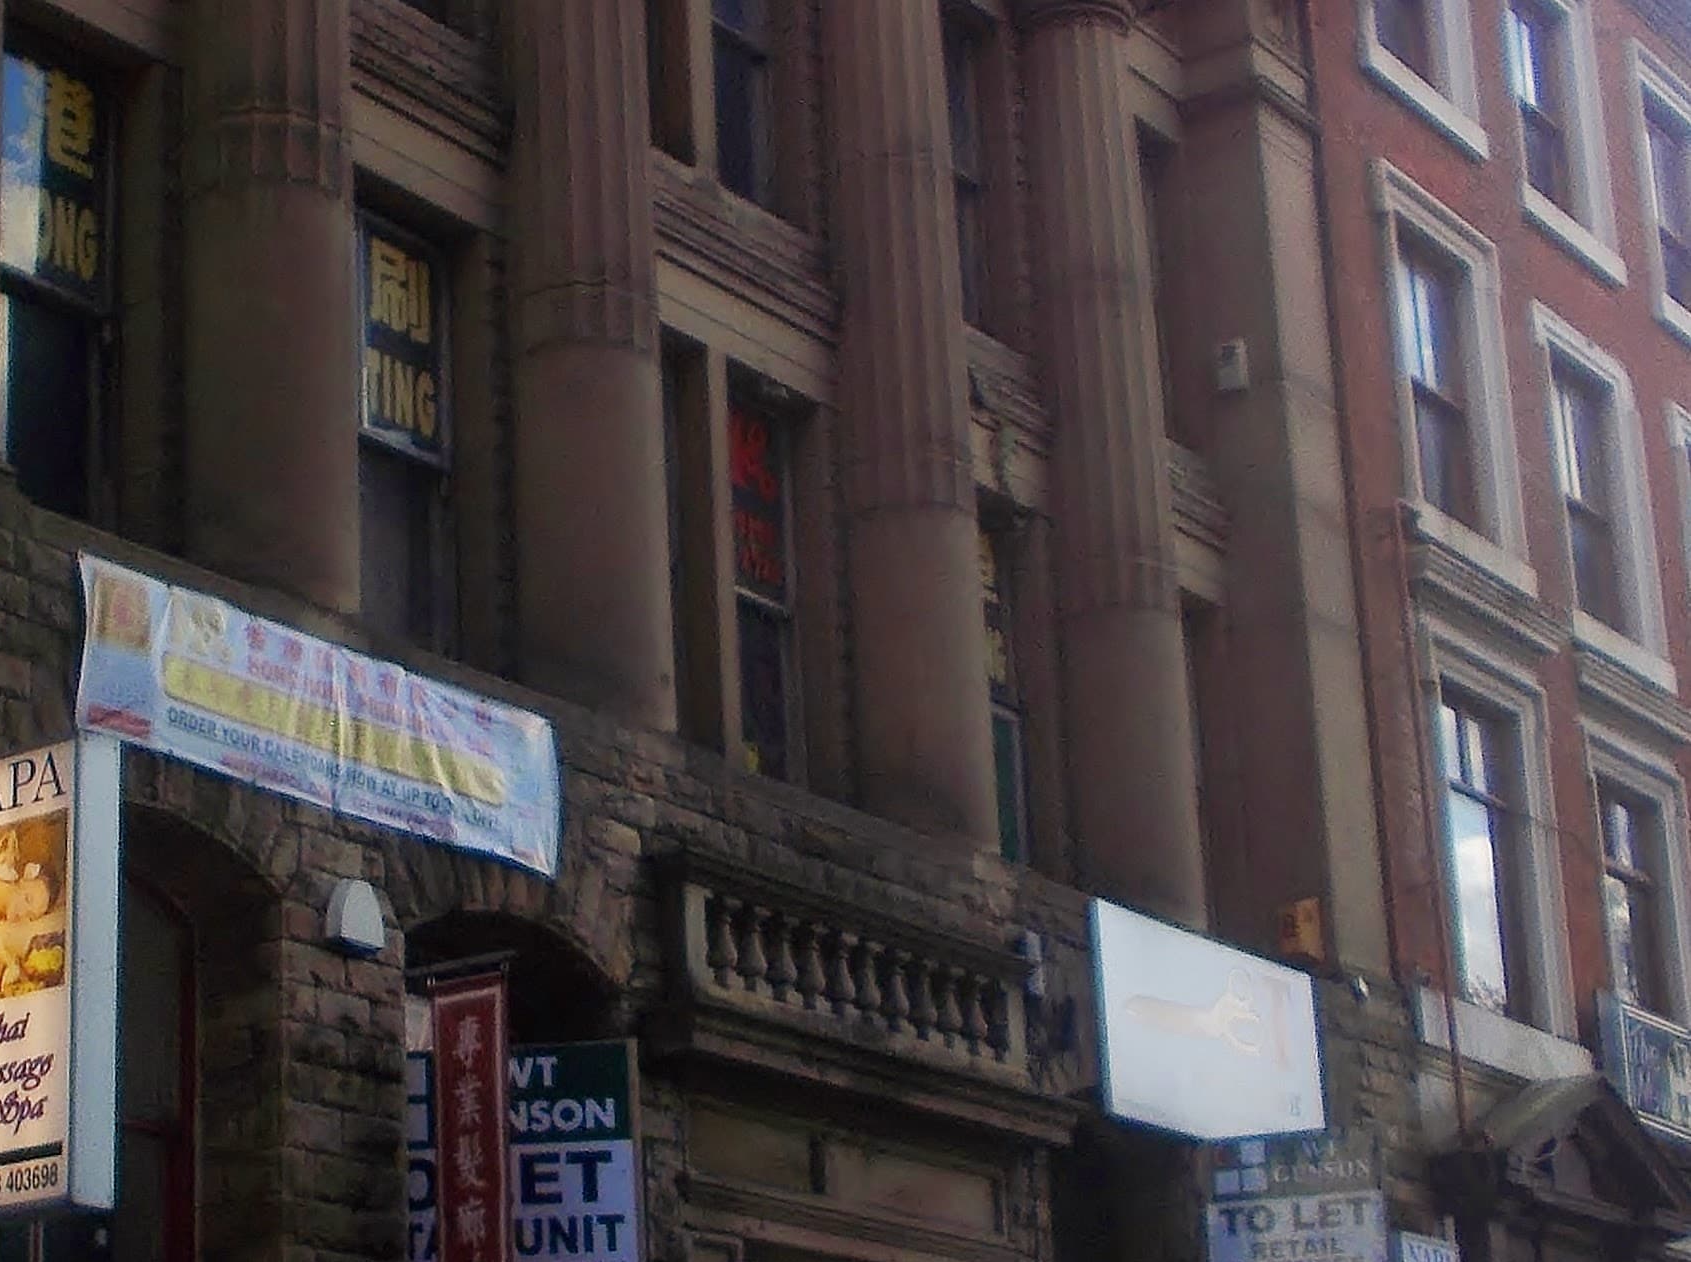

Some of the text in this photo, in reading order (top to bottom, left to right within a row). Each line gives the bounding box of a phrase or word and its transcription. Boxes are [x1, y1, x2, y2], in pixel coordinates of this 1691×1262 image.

[167, 706, 219, 738] ORDER
[222, 727, 261, 755] YOUR
[510, 1098, 616, 1133] NSON
[7, 1163, 59, 1193] 403698
[520, 1151, 612, 1204] ET
[516, 1215, 625, 1256] UNIT
[1219, 1199, 1368, 1236] TO LET
